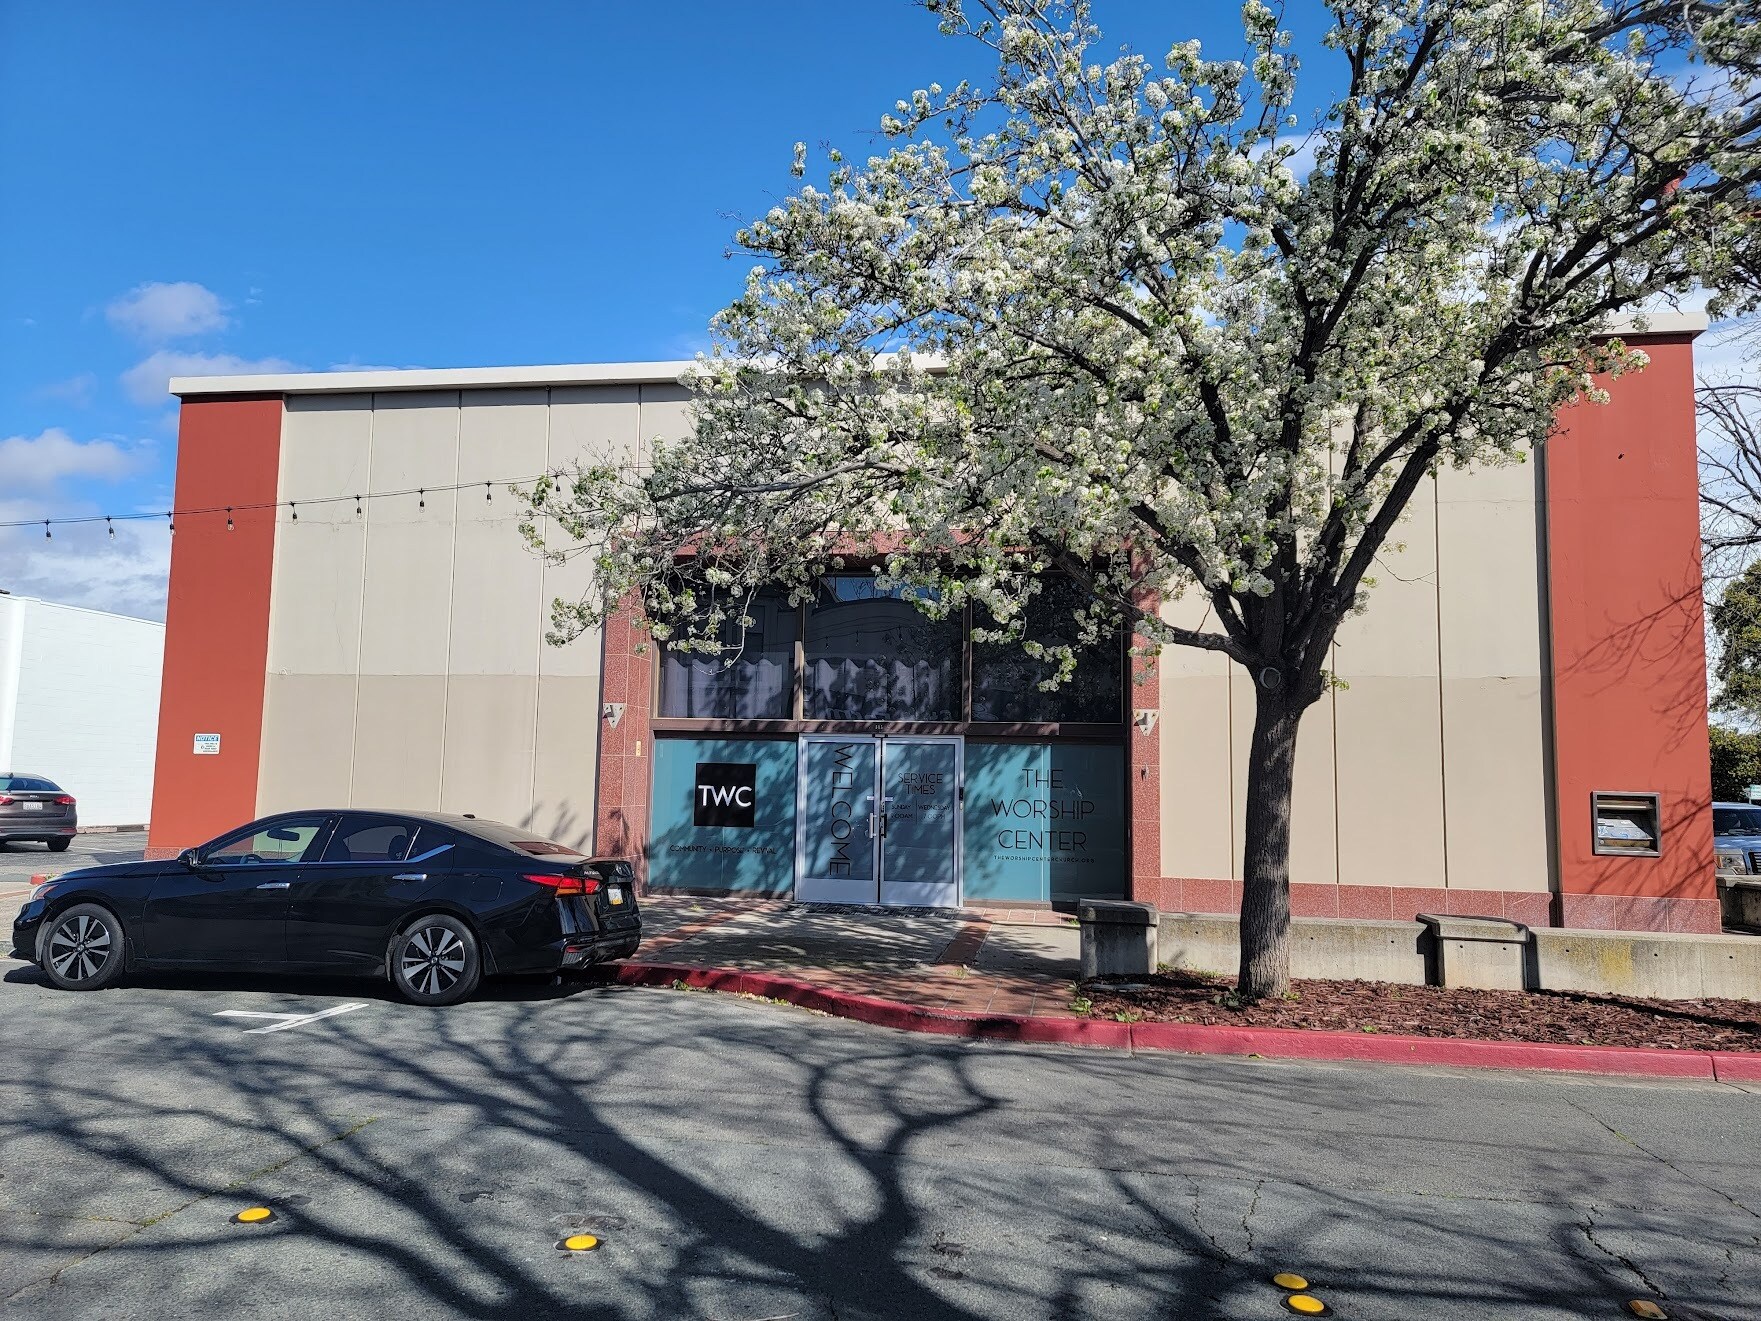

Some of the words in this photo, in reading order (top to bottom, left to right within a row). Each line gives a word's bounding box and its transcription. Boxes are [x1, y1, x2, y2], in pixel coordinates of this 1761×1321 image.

[898, 773, 943, 784] SERVICE
[1022, 768, 1063, 789] THE
[698, 785, 752, 807] TWC
[906, 784, 935, 795] TIMES
[829, 744, 854, 876] WELCOME
[991, 798, 1095, 820] WORSHIP
[669, 844, 707, 853] COMMUNITY
[714, 846, 744, 854] PURPOSE
[752, 847, 778, 855] REVIVAL
[998, 829, 1087, 851] CENTER
